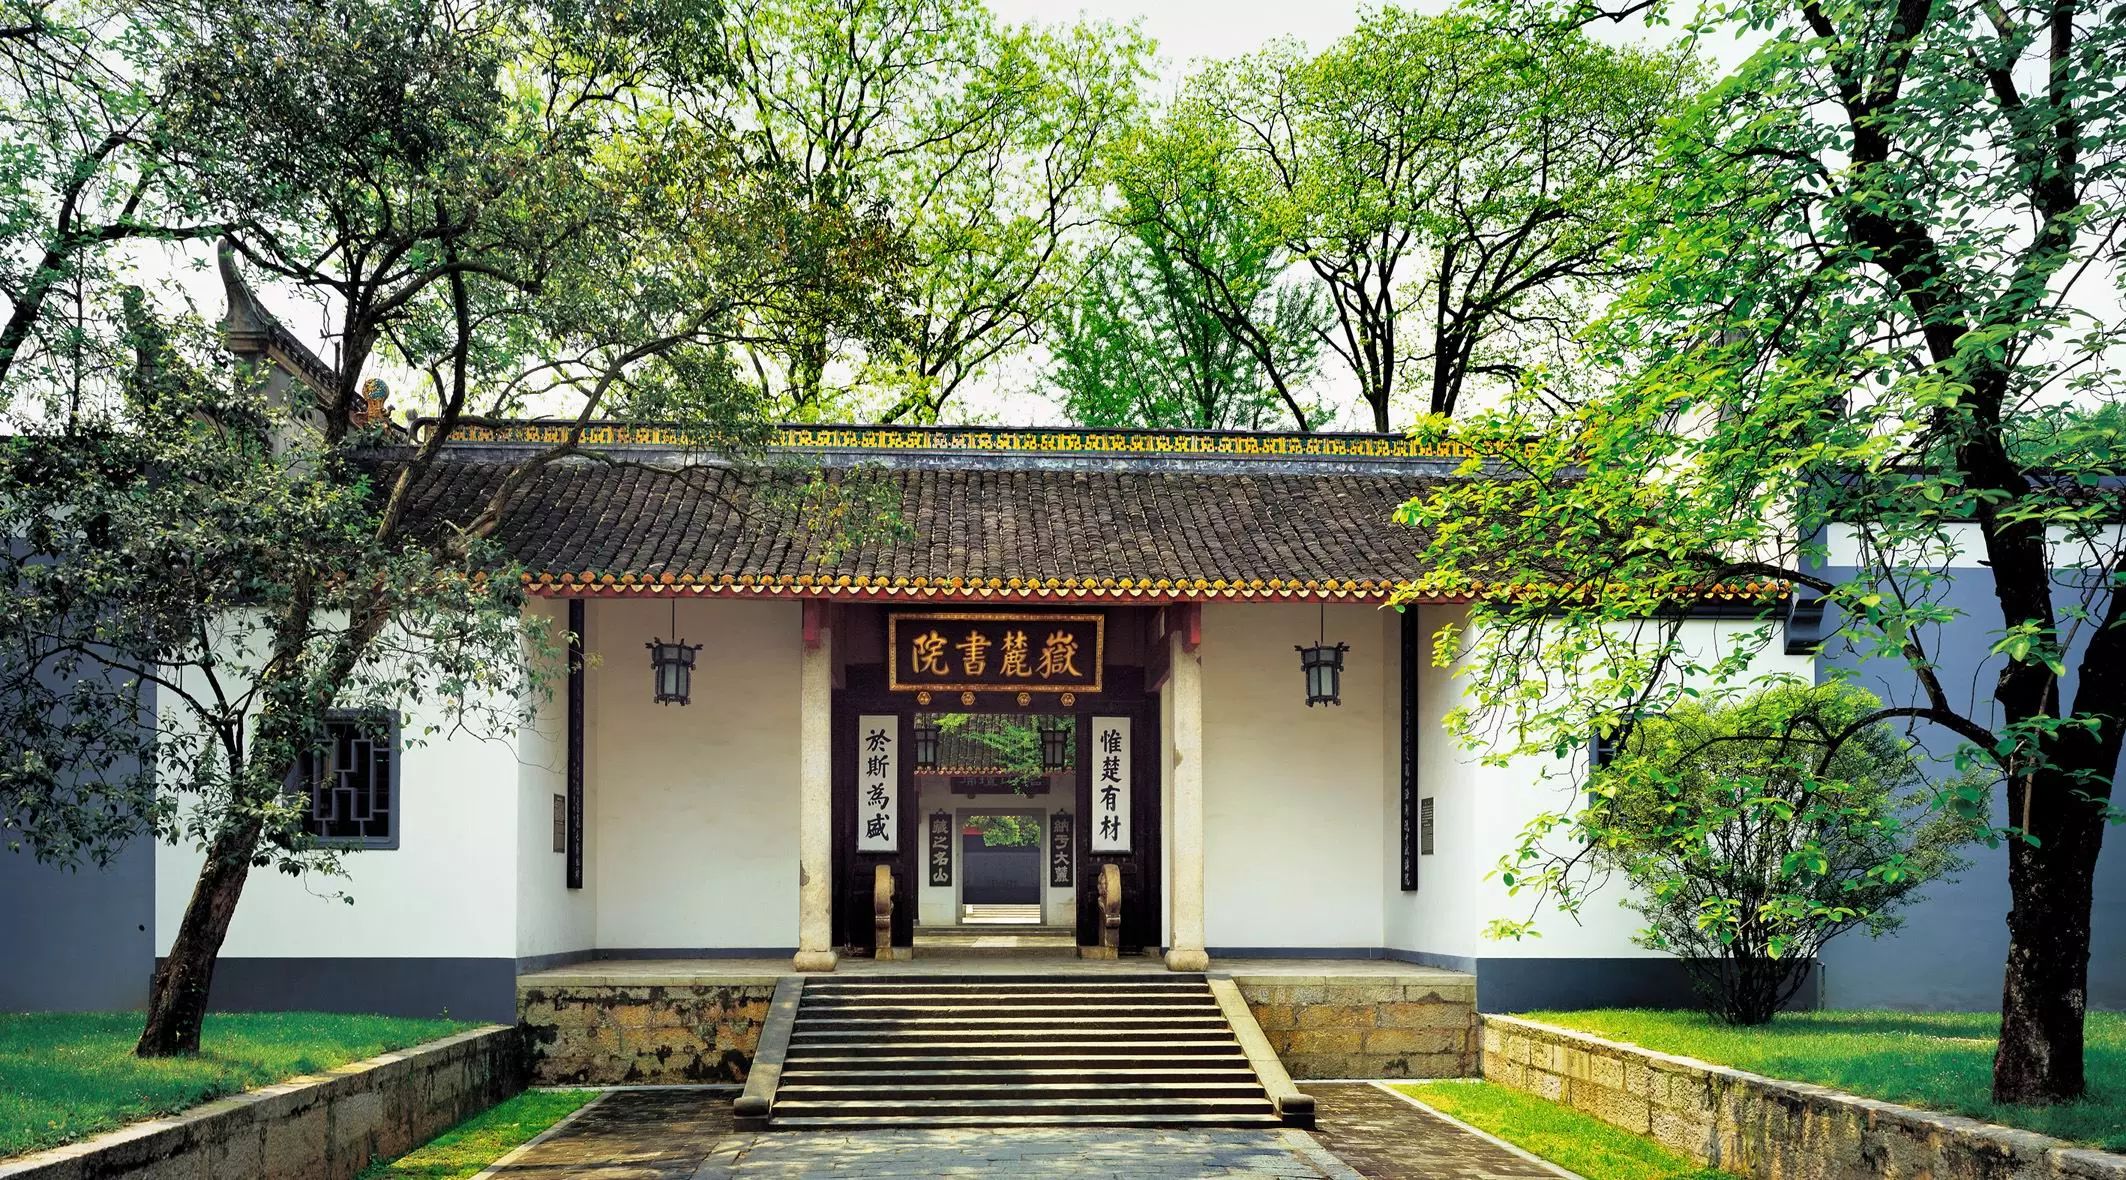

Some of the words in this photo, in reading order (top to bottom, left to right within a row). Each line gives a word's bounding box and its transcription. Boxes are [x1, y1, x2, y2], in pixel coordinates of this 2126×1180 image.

[912, 629, 1083, 680] 嶽麓書院
[865, 728, 892, 842] 於斯為盛
[1099, 728, 1122, 842] 惟楚有材
[931, 819, 949, 883] 藏之名山
